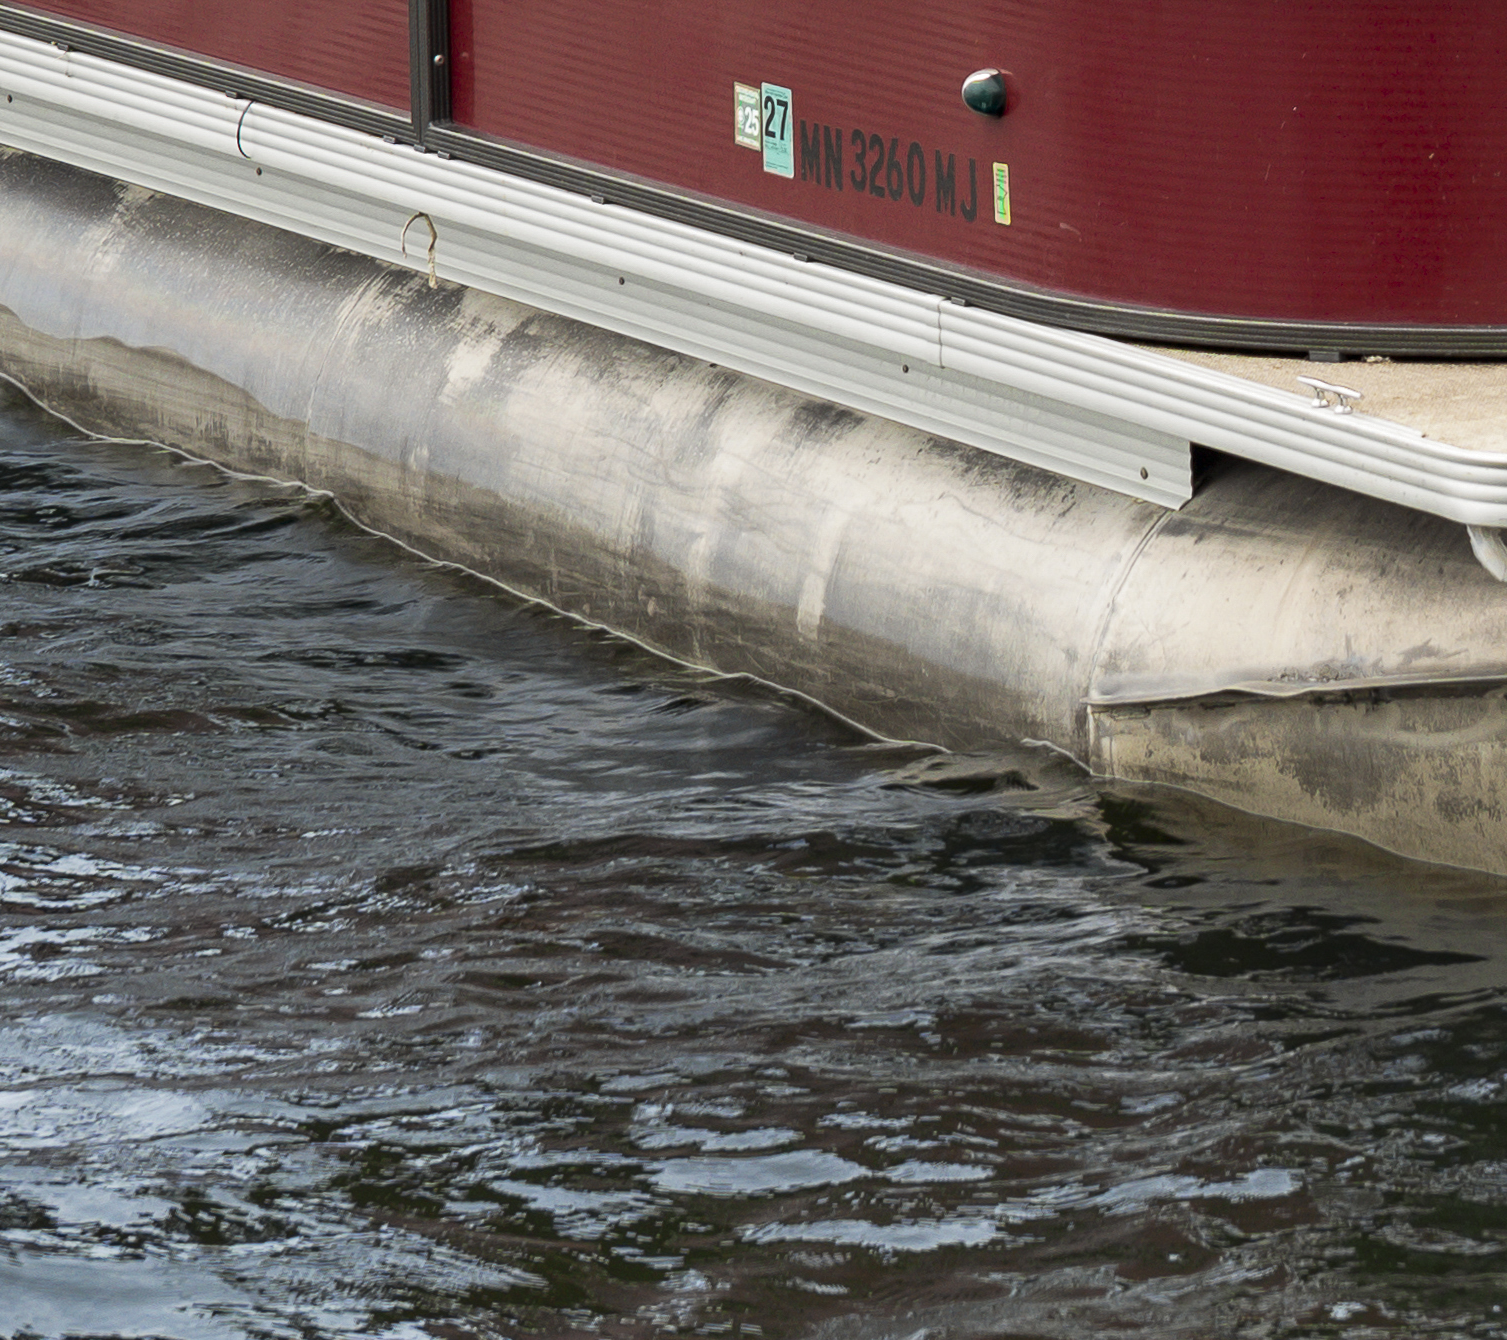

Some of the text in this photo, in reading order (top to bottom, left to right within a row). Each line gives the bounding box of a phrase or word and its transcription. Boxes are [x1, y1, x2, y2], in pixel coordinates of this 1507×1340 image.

[744, 106, 759, 136] 25
[764, 95, 788, 140] 27
[800, 119, 977, 221] MN 3260 MJ
